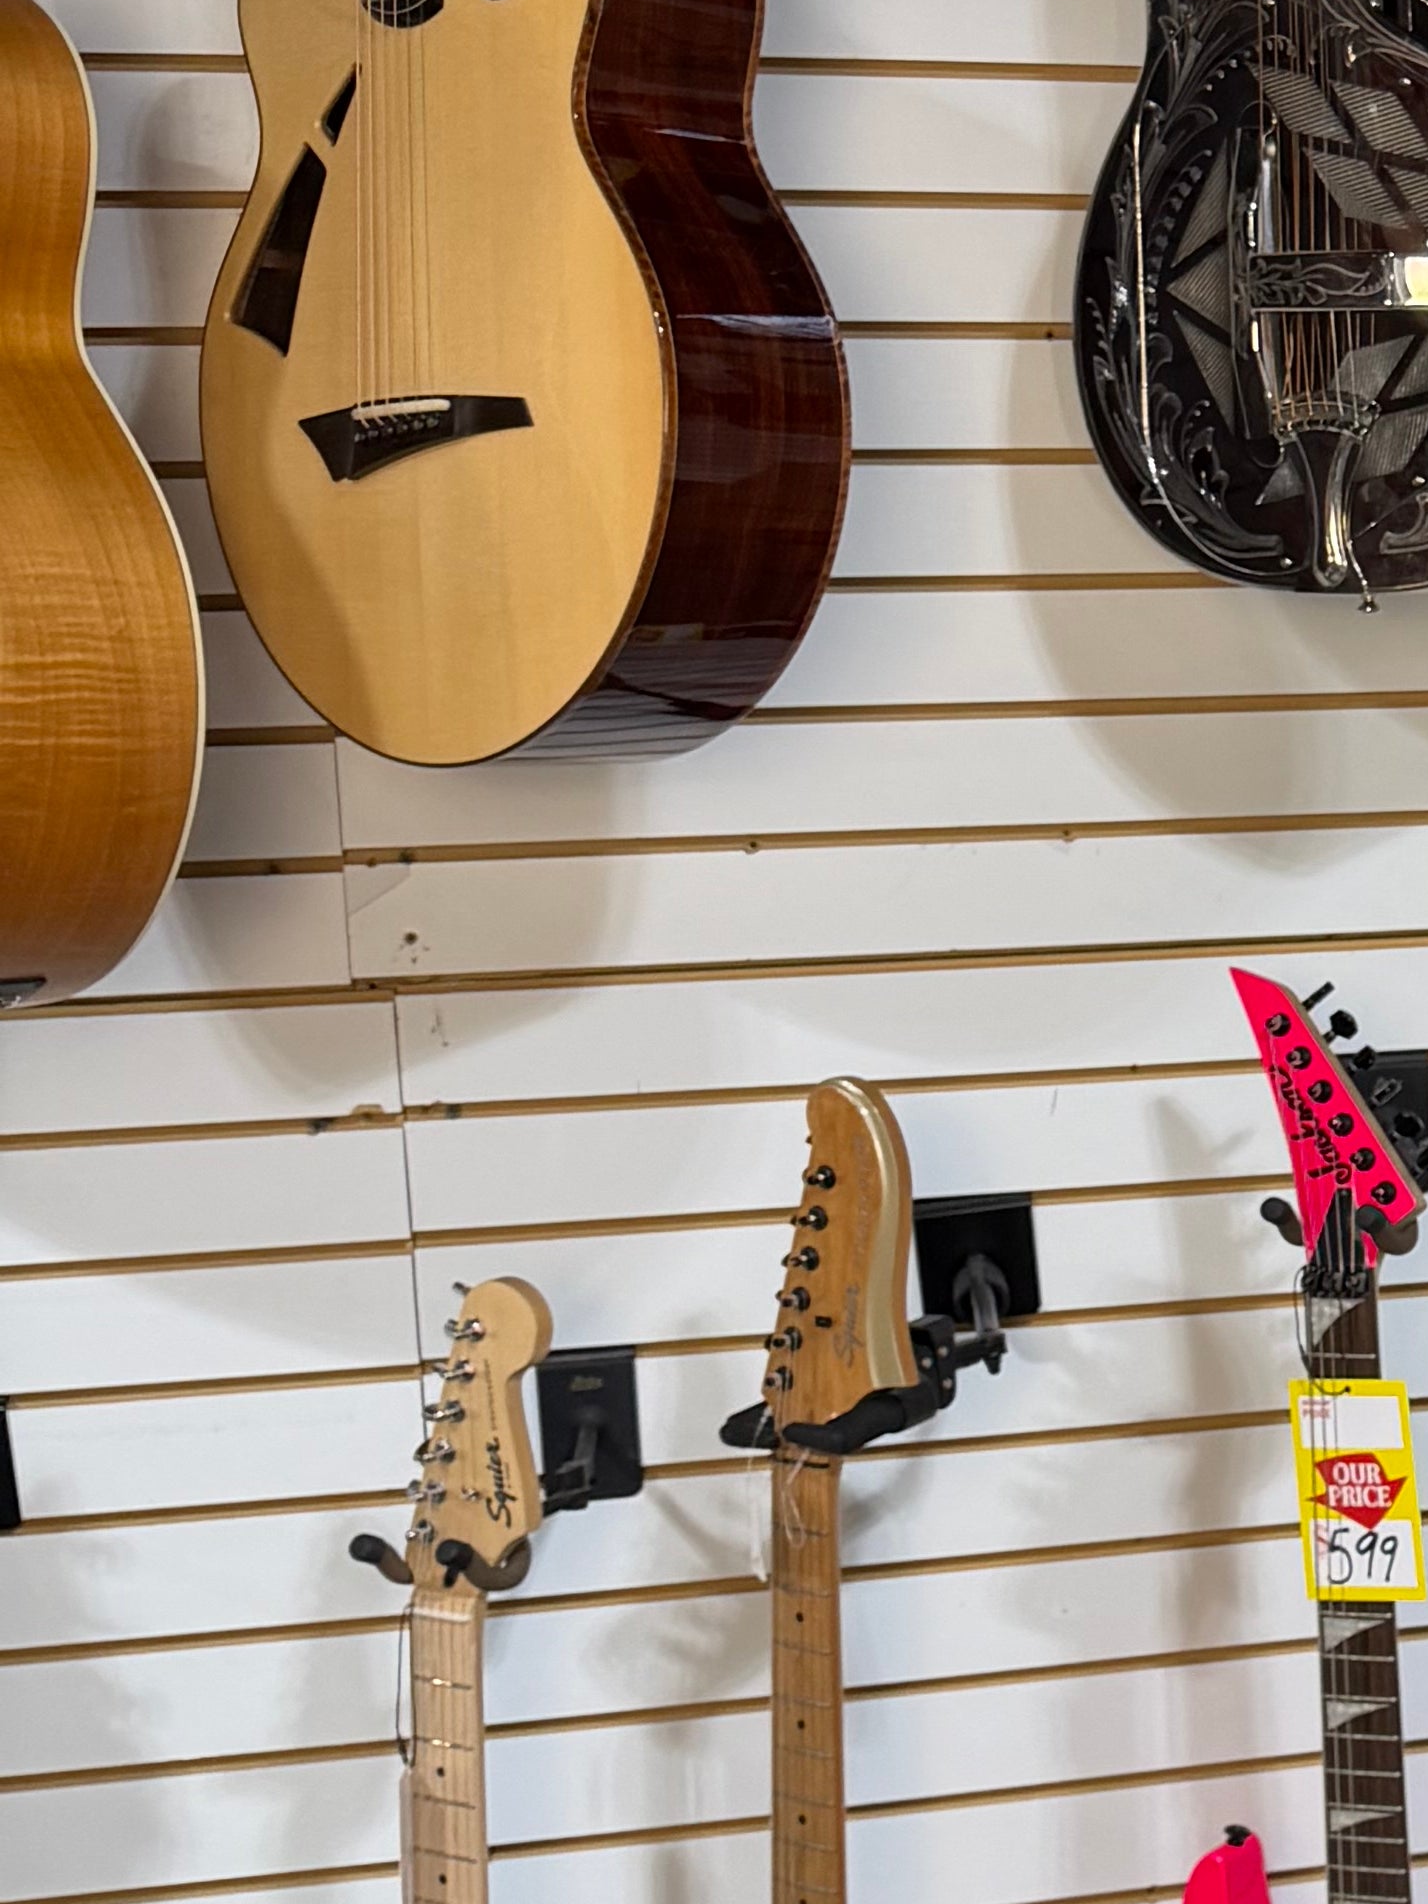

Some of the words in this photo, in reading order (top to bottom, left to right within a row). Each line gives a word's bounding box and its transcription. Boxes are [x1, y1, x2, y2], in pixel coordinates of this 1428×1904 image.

[485, 1436, 518, 1528] Squier
[1332, 1462, 1382, 1485] OUR
[1327, 1485, 1393, 1508] PRICE
